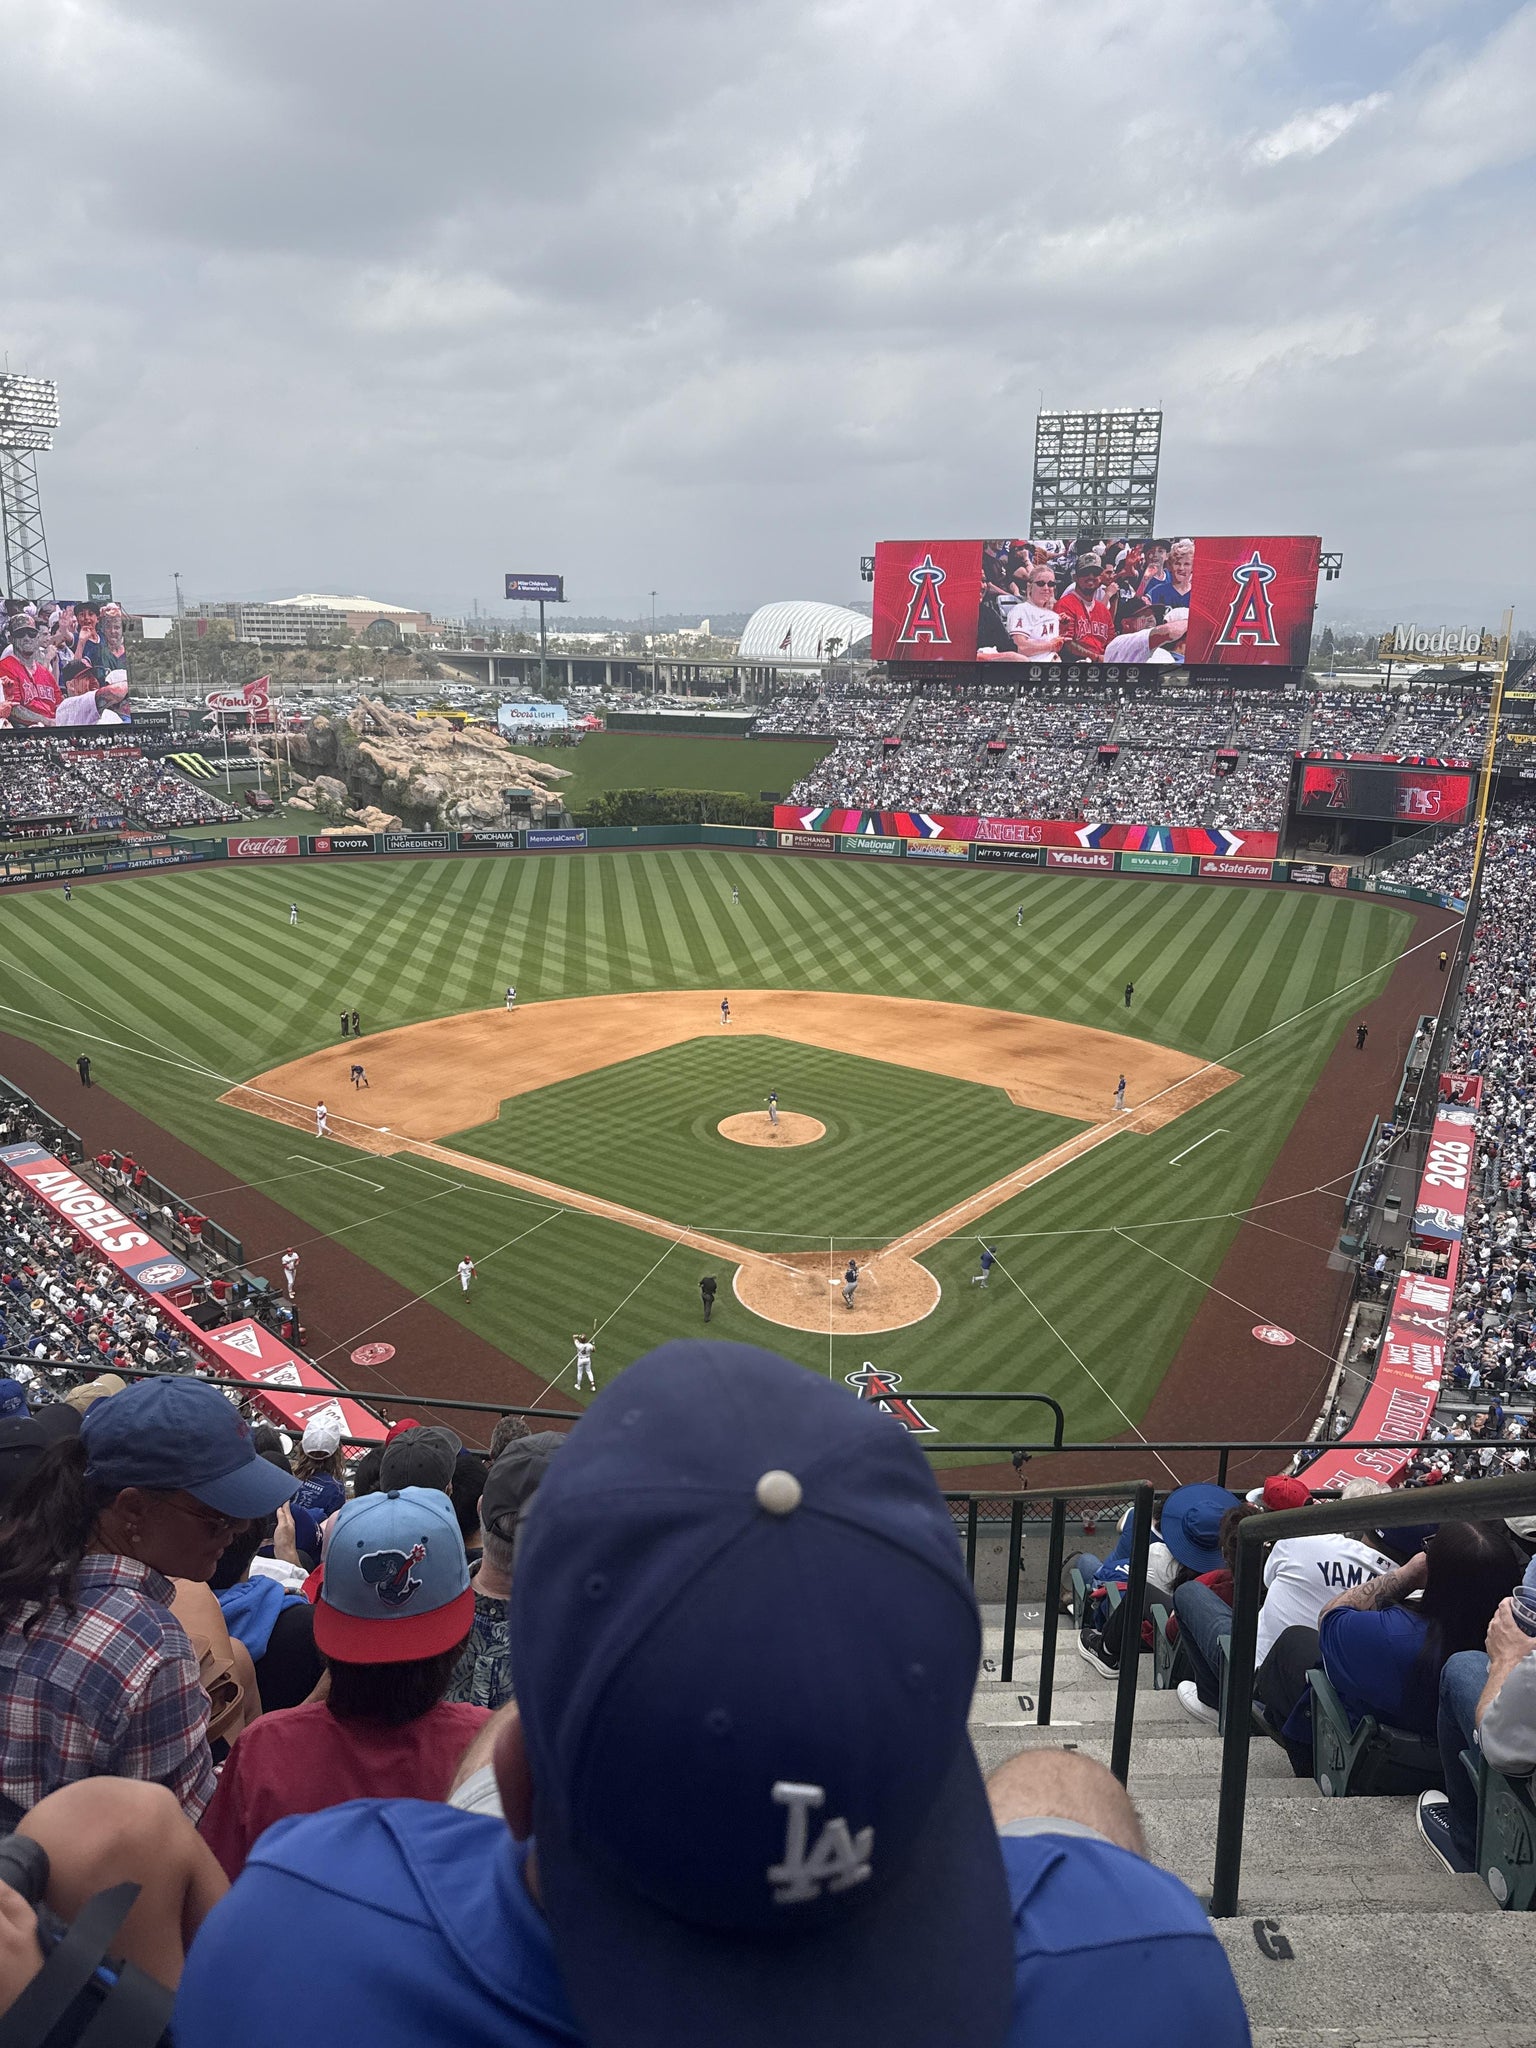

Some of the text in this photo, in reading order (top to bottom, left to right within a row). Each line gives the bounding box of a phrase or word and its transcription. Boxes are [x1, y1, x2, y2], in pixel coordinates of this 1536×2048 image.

[1393, 623, 1481, 653] Modelo
[510, 709, 555, 719] Coors LIGHT
[974, 817, 1042, 842] ANGELS
[474, 833, 514, 841] YOKOHAMA
[530, 834, 576, 843] MemorialCare
[794, 836, 831, 844] PECHANGA
[237, 838, 289, 855] Coca-Cola
[333, 840, 368, 848] TOYOTA
[857, 839, 895, 850] National
[910, 842, 945, 854] Surfside
[1003, 850, 1038, 860] TIRE.COM
[1052, 852, 1110, 866] Yakult
[34, 867, 85, 880] NITTO TIRE.COM
[1424, 1140, 1471, 1190] 2026
[25, 1170, 150, 1253] ANGELS
[982, 1659, 996, 1672] C
[1017, 1695, 1035, 1712] D
[766, 1780, 875, 1903] LA
[1252, 1919, 1294, 1961] G
